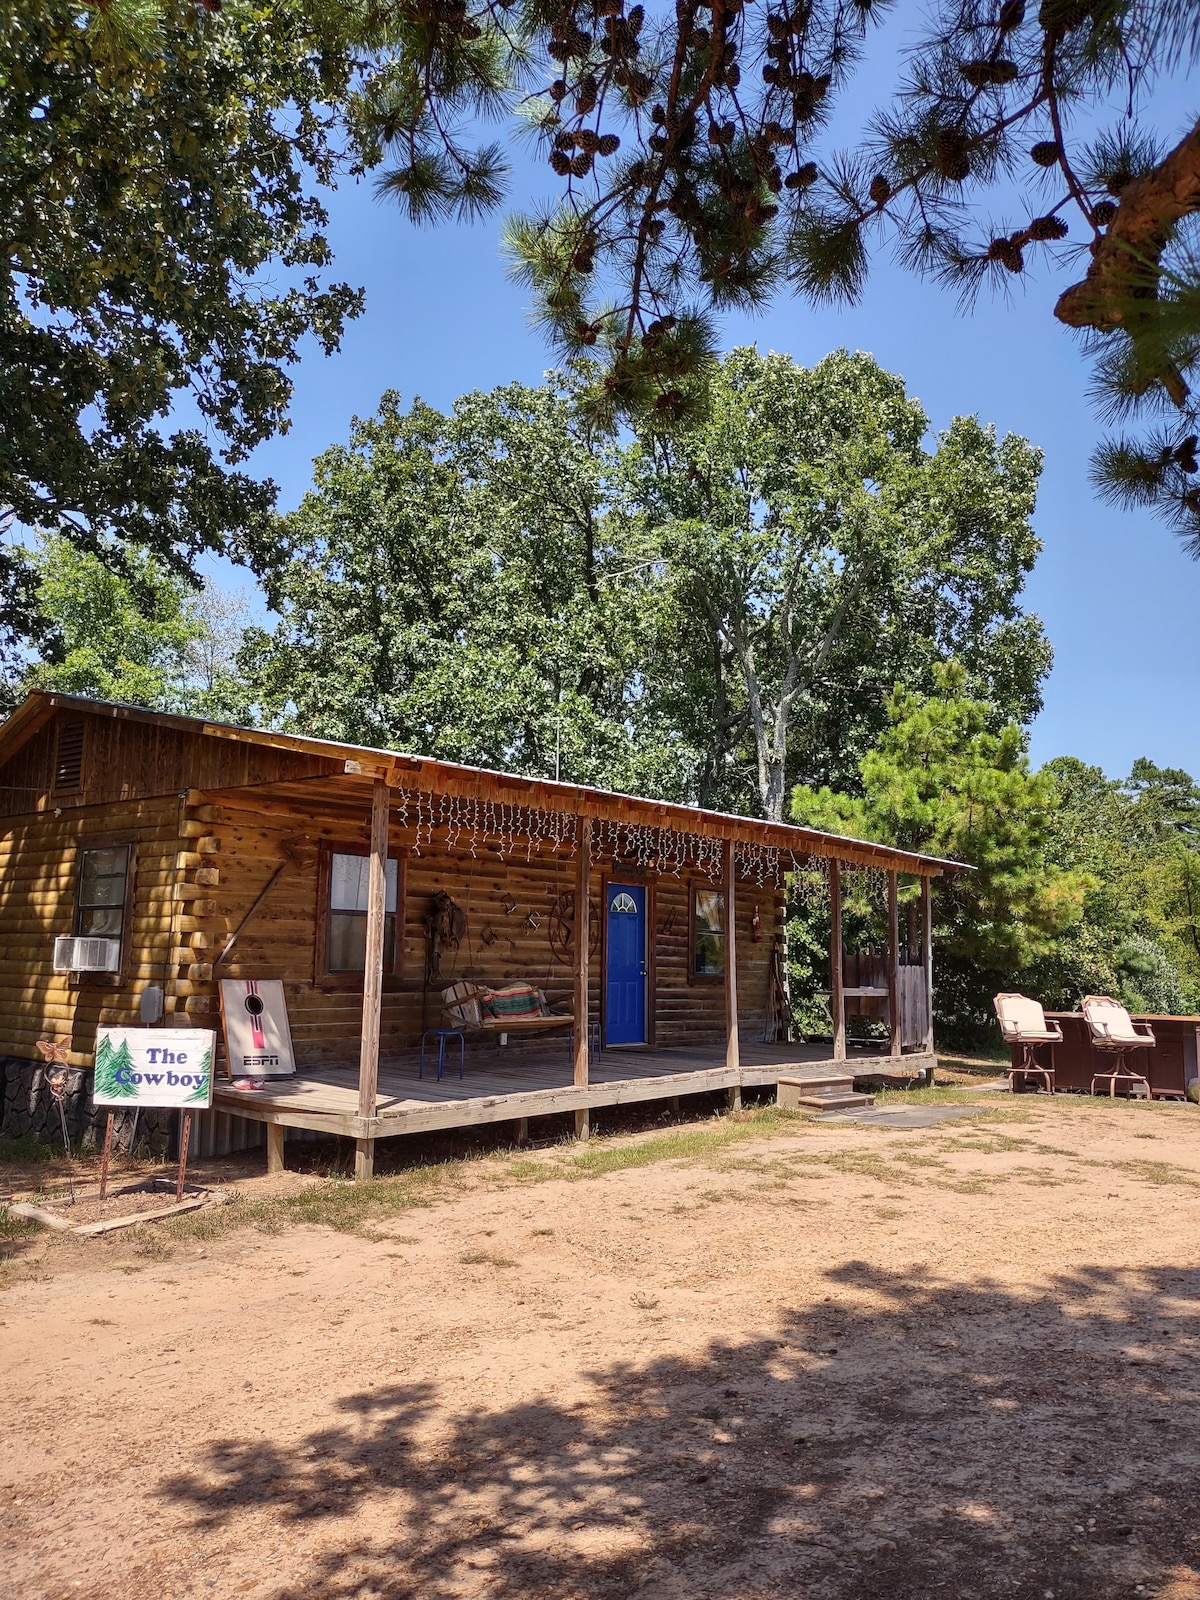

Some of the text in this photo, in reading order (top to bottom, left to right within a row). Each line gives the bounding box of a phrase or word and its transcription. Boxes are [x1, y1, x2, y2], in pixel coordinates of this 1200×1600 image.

[146, 1048, 188, 1064] The
[243, 1055, 279, 1066] ESPN
[115, 1067, 207, 1090] Cowboy
